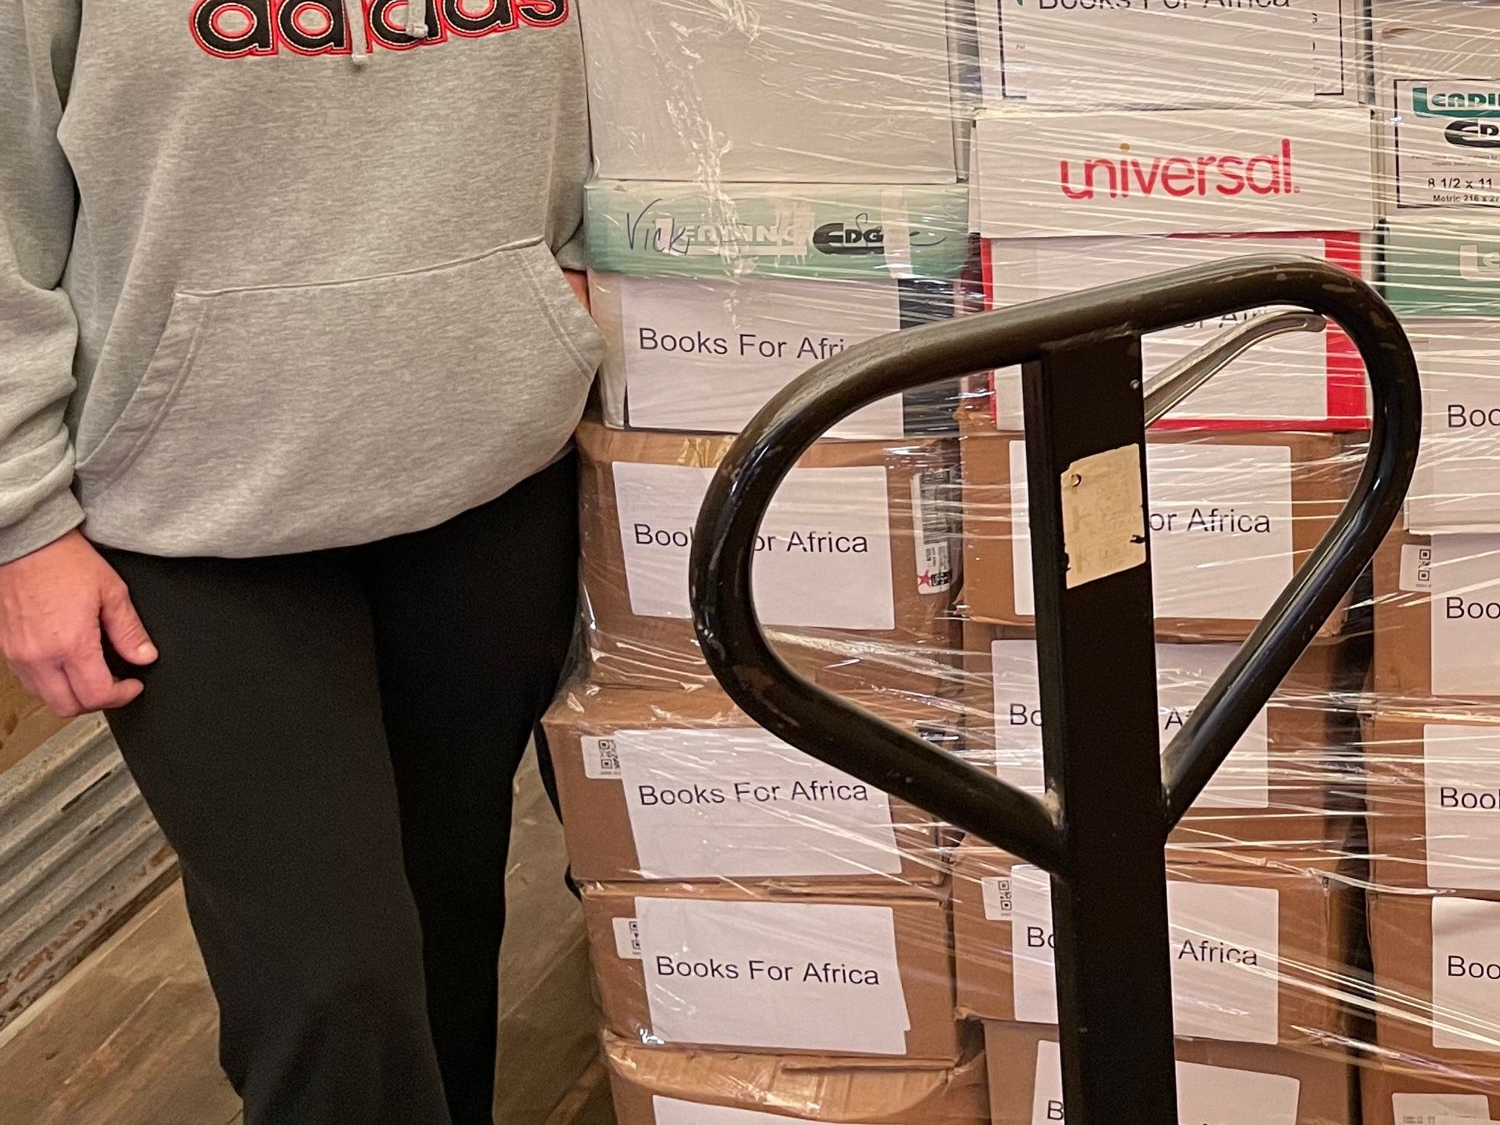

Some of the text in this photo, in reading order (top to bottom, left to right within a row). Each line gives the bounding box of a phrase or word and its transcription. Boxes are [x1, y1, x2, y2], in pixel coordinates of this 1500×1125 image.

[1428, 178, 1435, 188] 8
[1441, 178, 1460, 189] 1/2
[1479, 178, 1493, 189] 11
[1433, 194, 1460, 202] Metric
[812, 222, 886, 256] EDG
[639, 327, 856, 361] Books For Afri
[1149, 508, 1271, 534] or Africa
[634, 523, 868, 554] Boo or Africa
[639, 779, 869, 806] Books For Africa
[1178, 939, 1259, 966] Africa
[656, 955, 881, 986] Books For Africa
